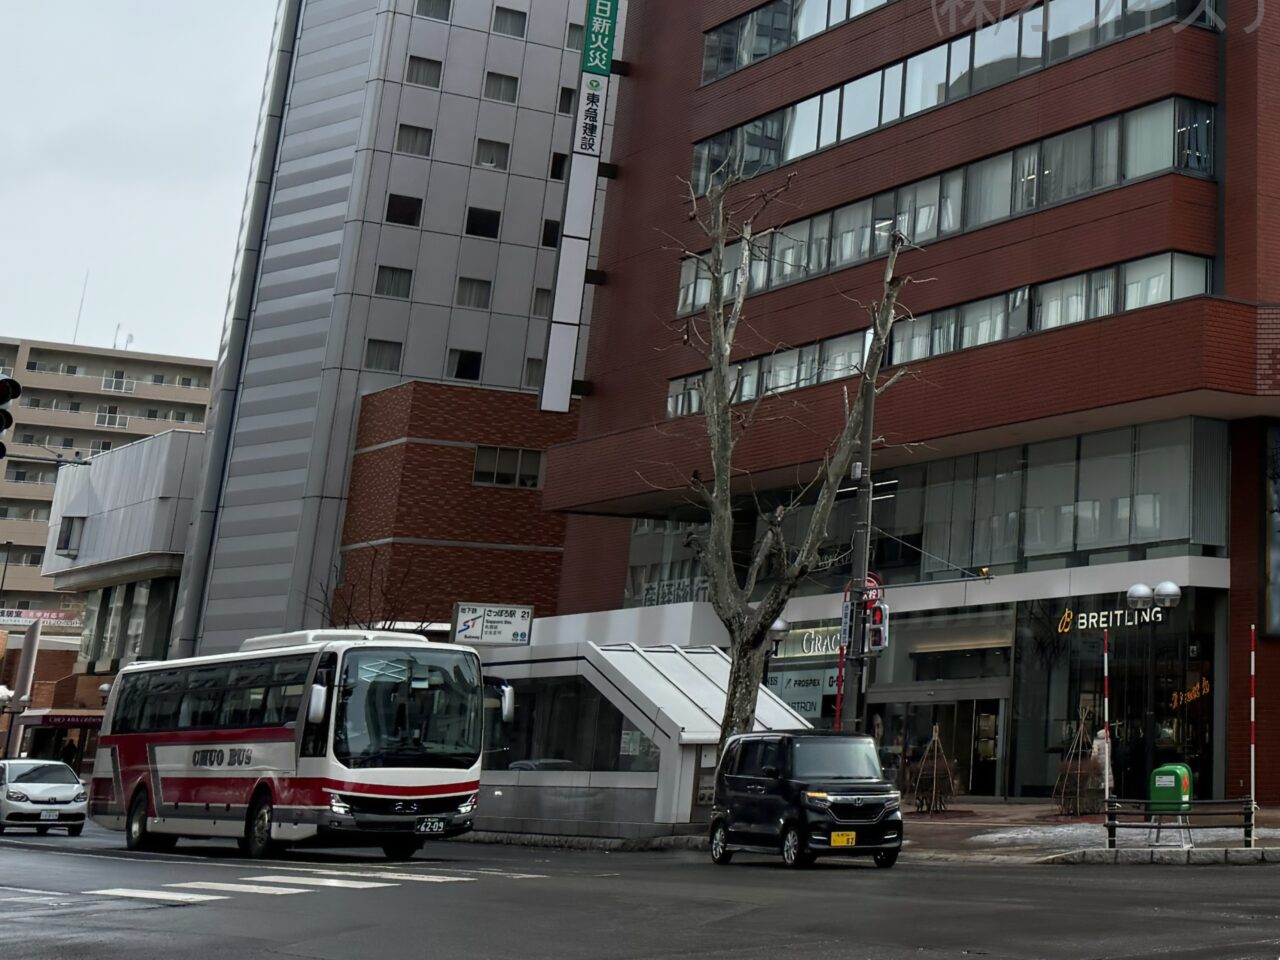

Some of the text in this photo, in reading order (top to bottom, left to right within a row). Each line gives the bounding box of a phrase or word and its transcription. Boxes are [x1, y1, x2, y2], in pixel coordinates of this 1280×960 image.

[580, 92, 600, 152] 東急建設
[486, 609, 517, 618] さっぽろ駅
[520, 610, 530, 619] 21
[1077, 607, 1163, 629] BREITLING
[793, 678, 821, 688] PROSPEX
[192, 747, 253, 767] CHUO BUS
[420, 821, 444, 832] 62-09
